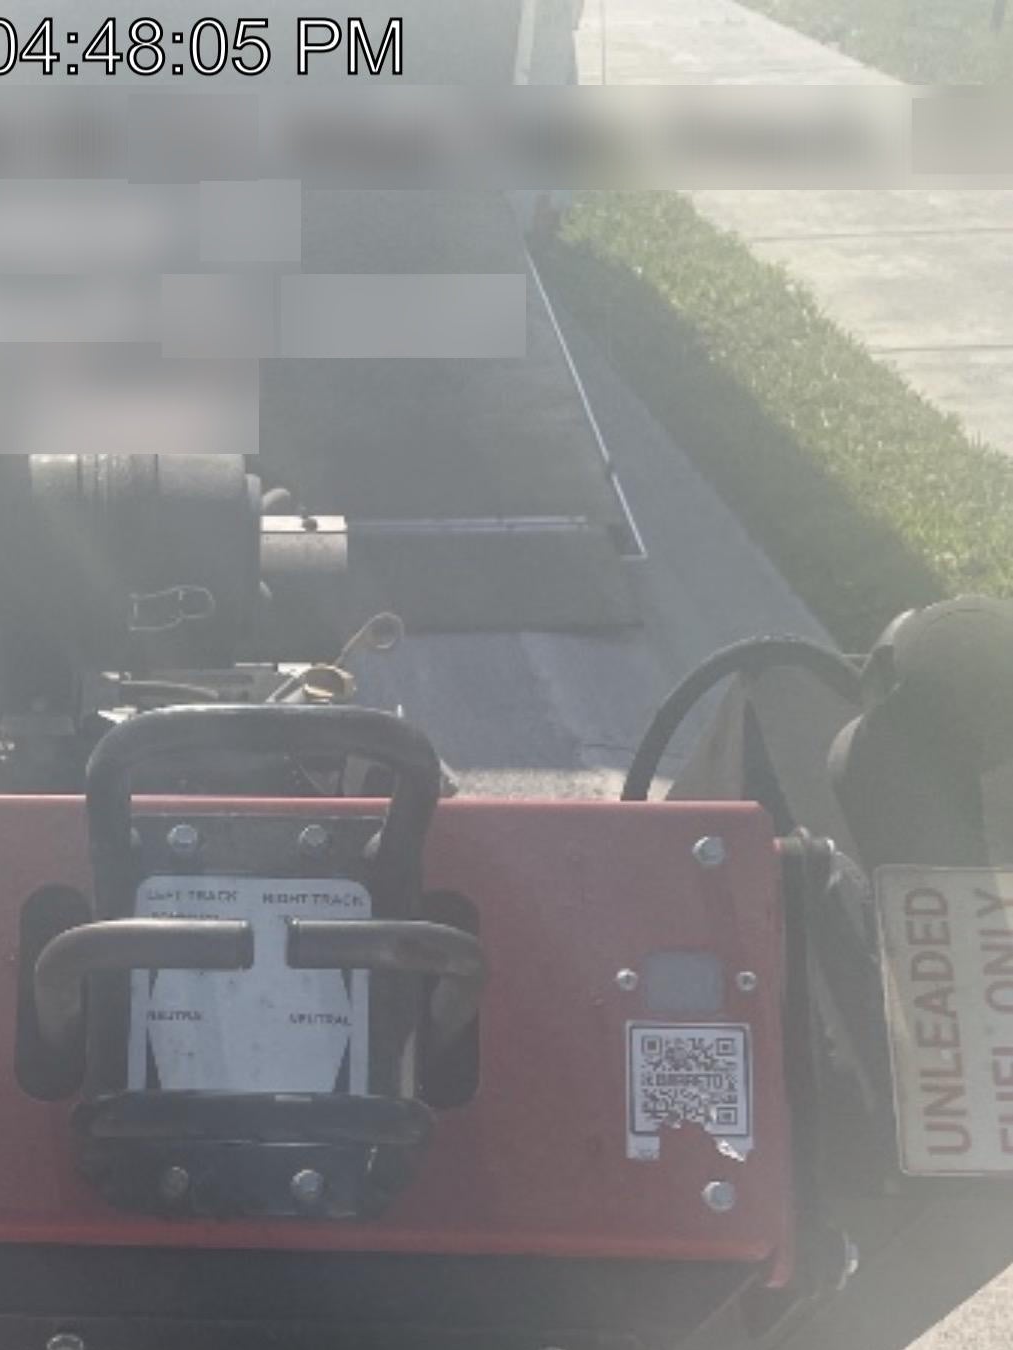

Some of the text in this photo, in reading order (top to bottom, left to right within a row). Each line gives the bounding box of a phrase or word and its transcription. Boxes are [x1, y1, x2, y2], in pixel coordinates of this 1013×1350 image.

[188, 889, 238, 902] TRACK
[262, 893, 364, 907] RIGHT TRACK
[904, 888, 973, 1155] UNLEADED
